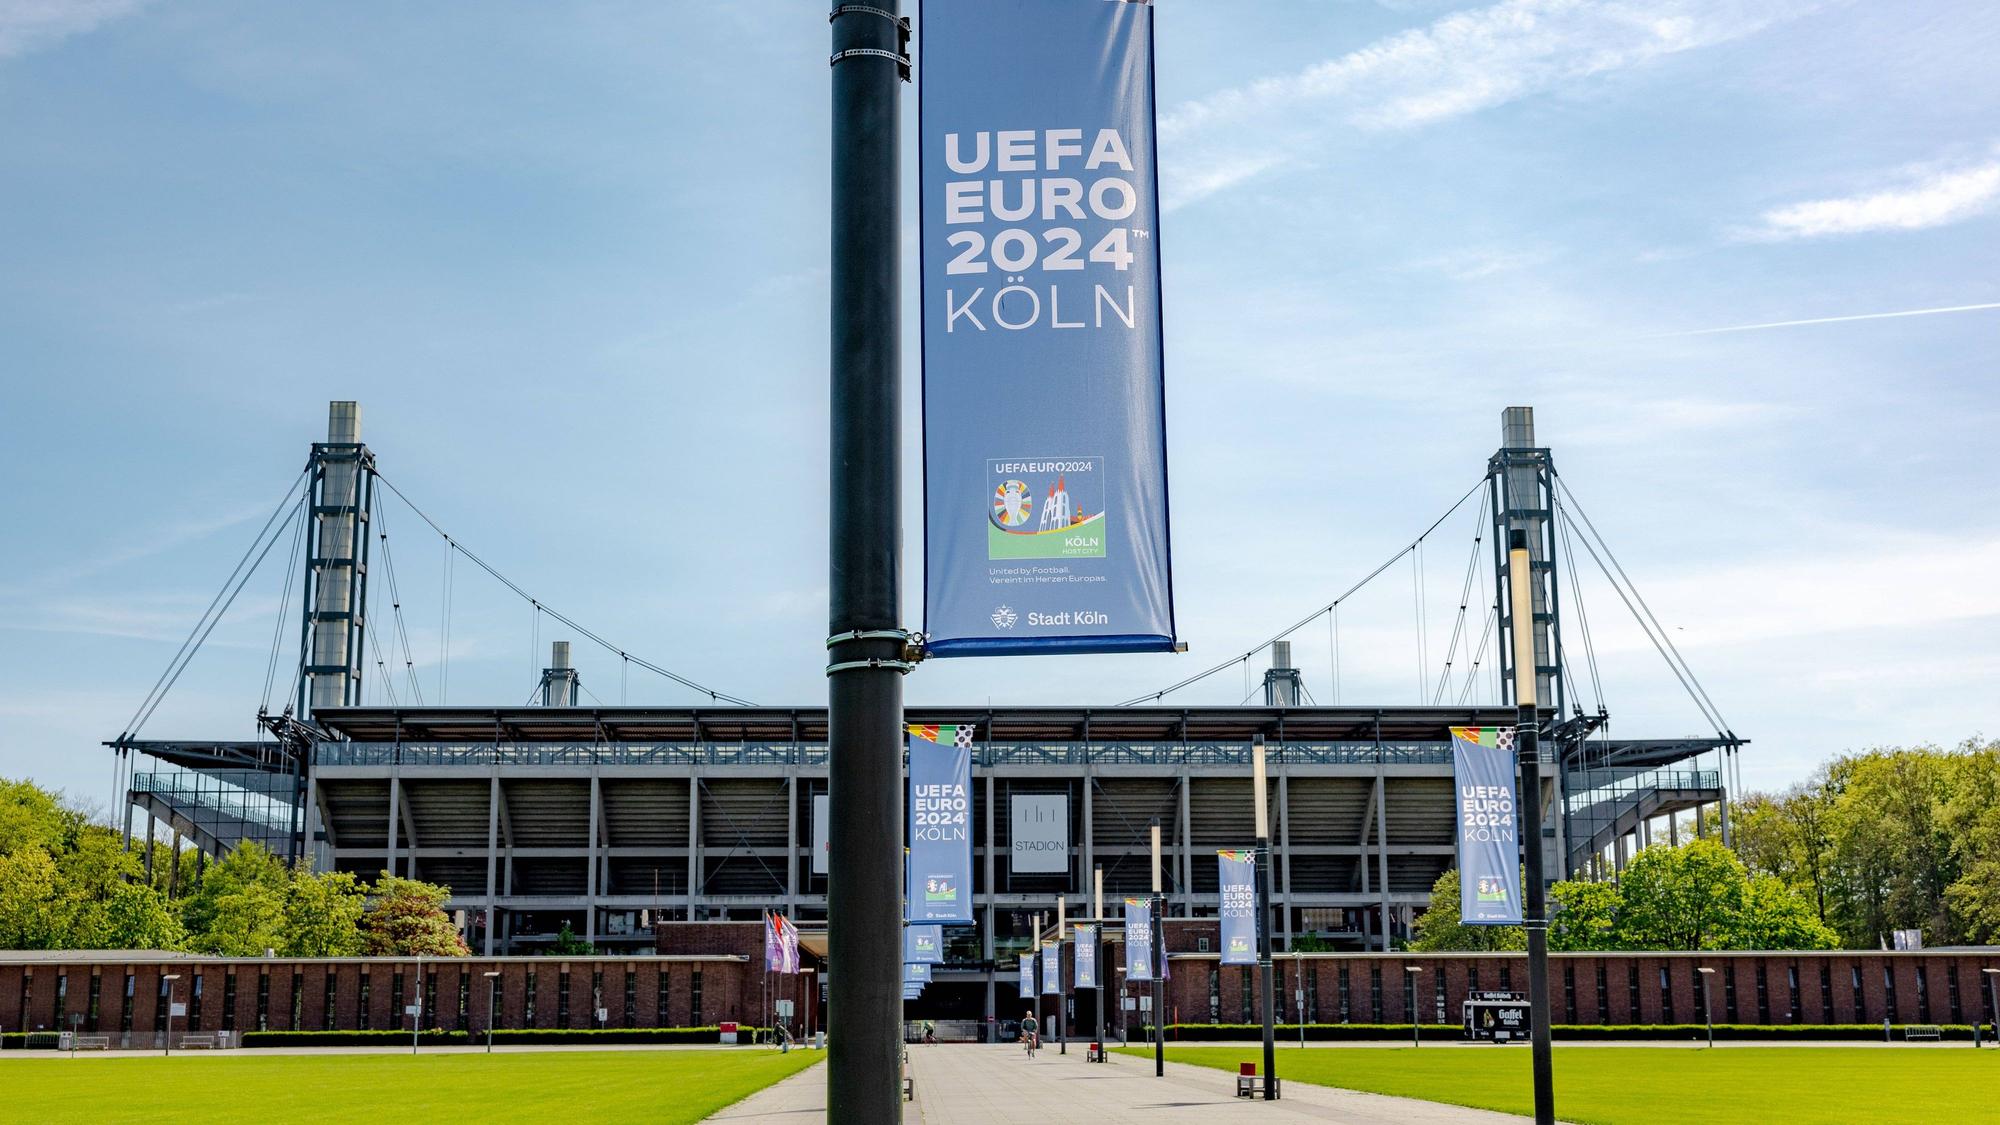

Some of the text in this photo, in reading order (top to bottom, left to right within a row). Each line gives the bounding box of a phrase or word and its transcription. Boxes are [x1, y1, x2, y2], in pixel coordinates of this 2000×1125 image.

[945, 128, 1134, 174] UEFA
[945, 177, 1137, 224] EURO
[946, 275, 1135, 333] KÖLN
[1065, 536, 1099, 547] KÖLN
[989, 566, 1070, 575] United by Football.
[989, 576, 1022, 584] Vereint
[1068, 575, 1107, 584] Europas.
[1028, 610, 1108, 626] Stadt Köln
[915, 784, 965, 797] UEFA
[1462, 785, 1511, 799] UEFA
[915, 798, 966, 811] EURO
[1463, 799, 1512, 813] EURO
[915, 825, 966, 841] KÖLN
[1464, 826, 1513, 842] KÖLN
[1015, 840, 1064, 851] STADION
[1223, 884, 1252, 893] UEFA
[1223, 892, 1253, 901] EURO
[1498, 1009, 1523, 1019] Gaffel
